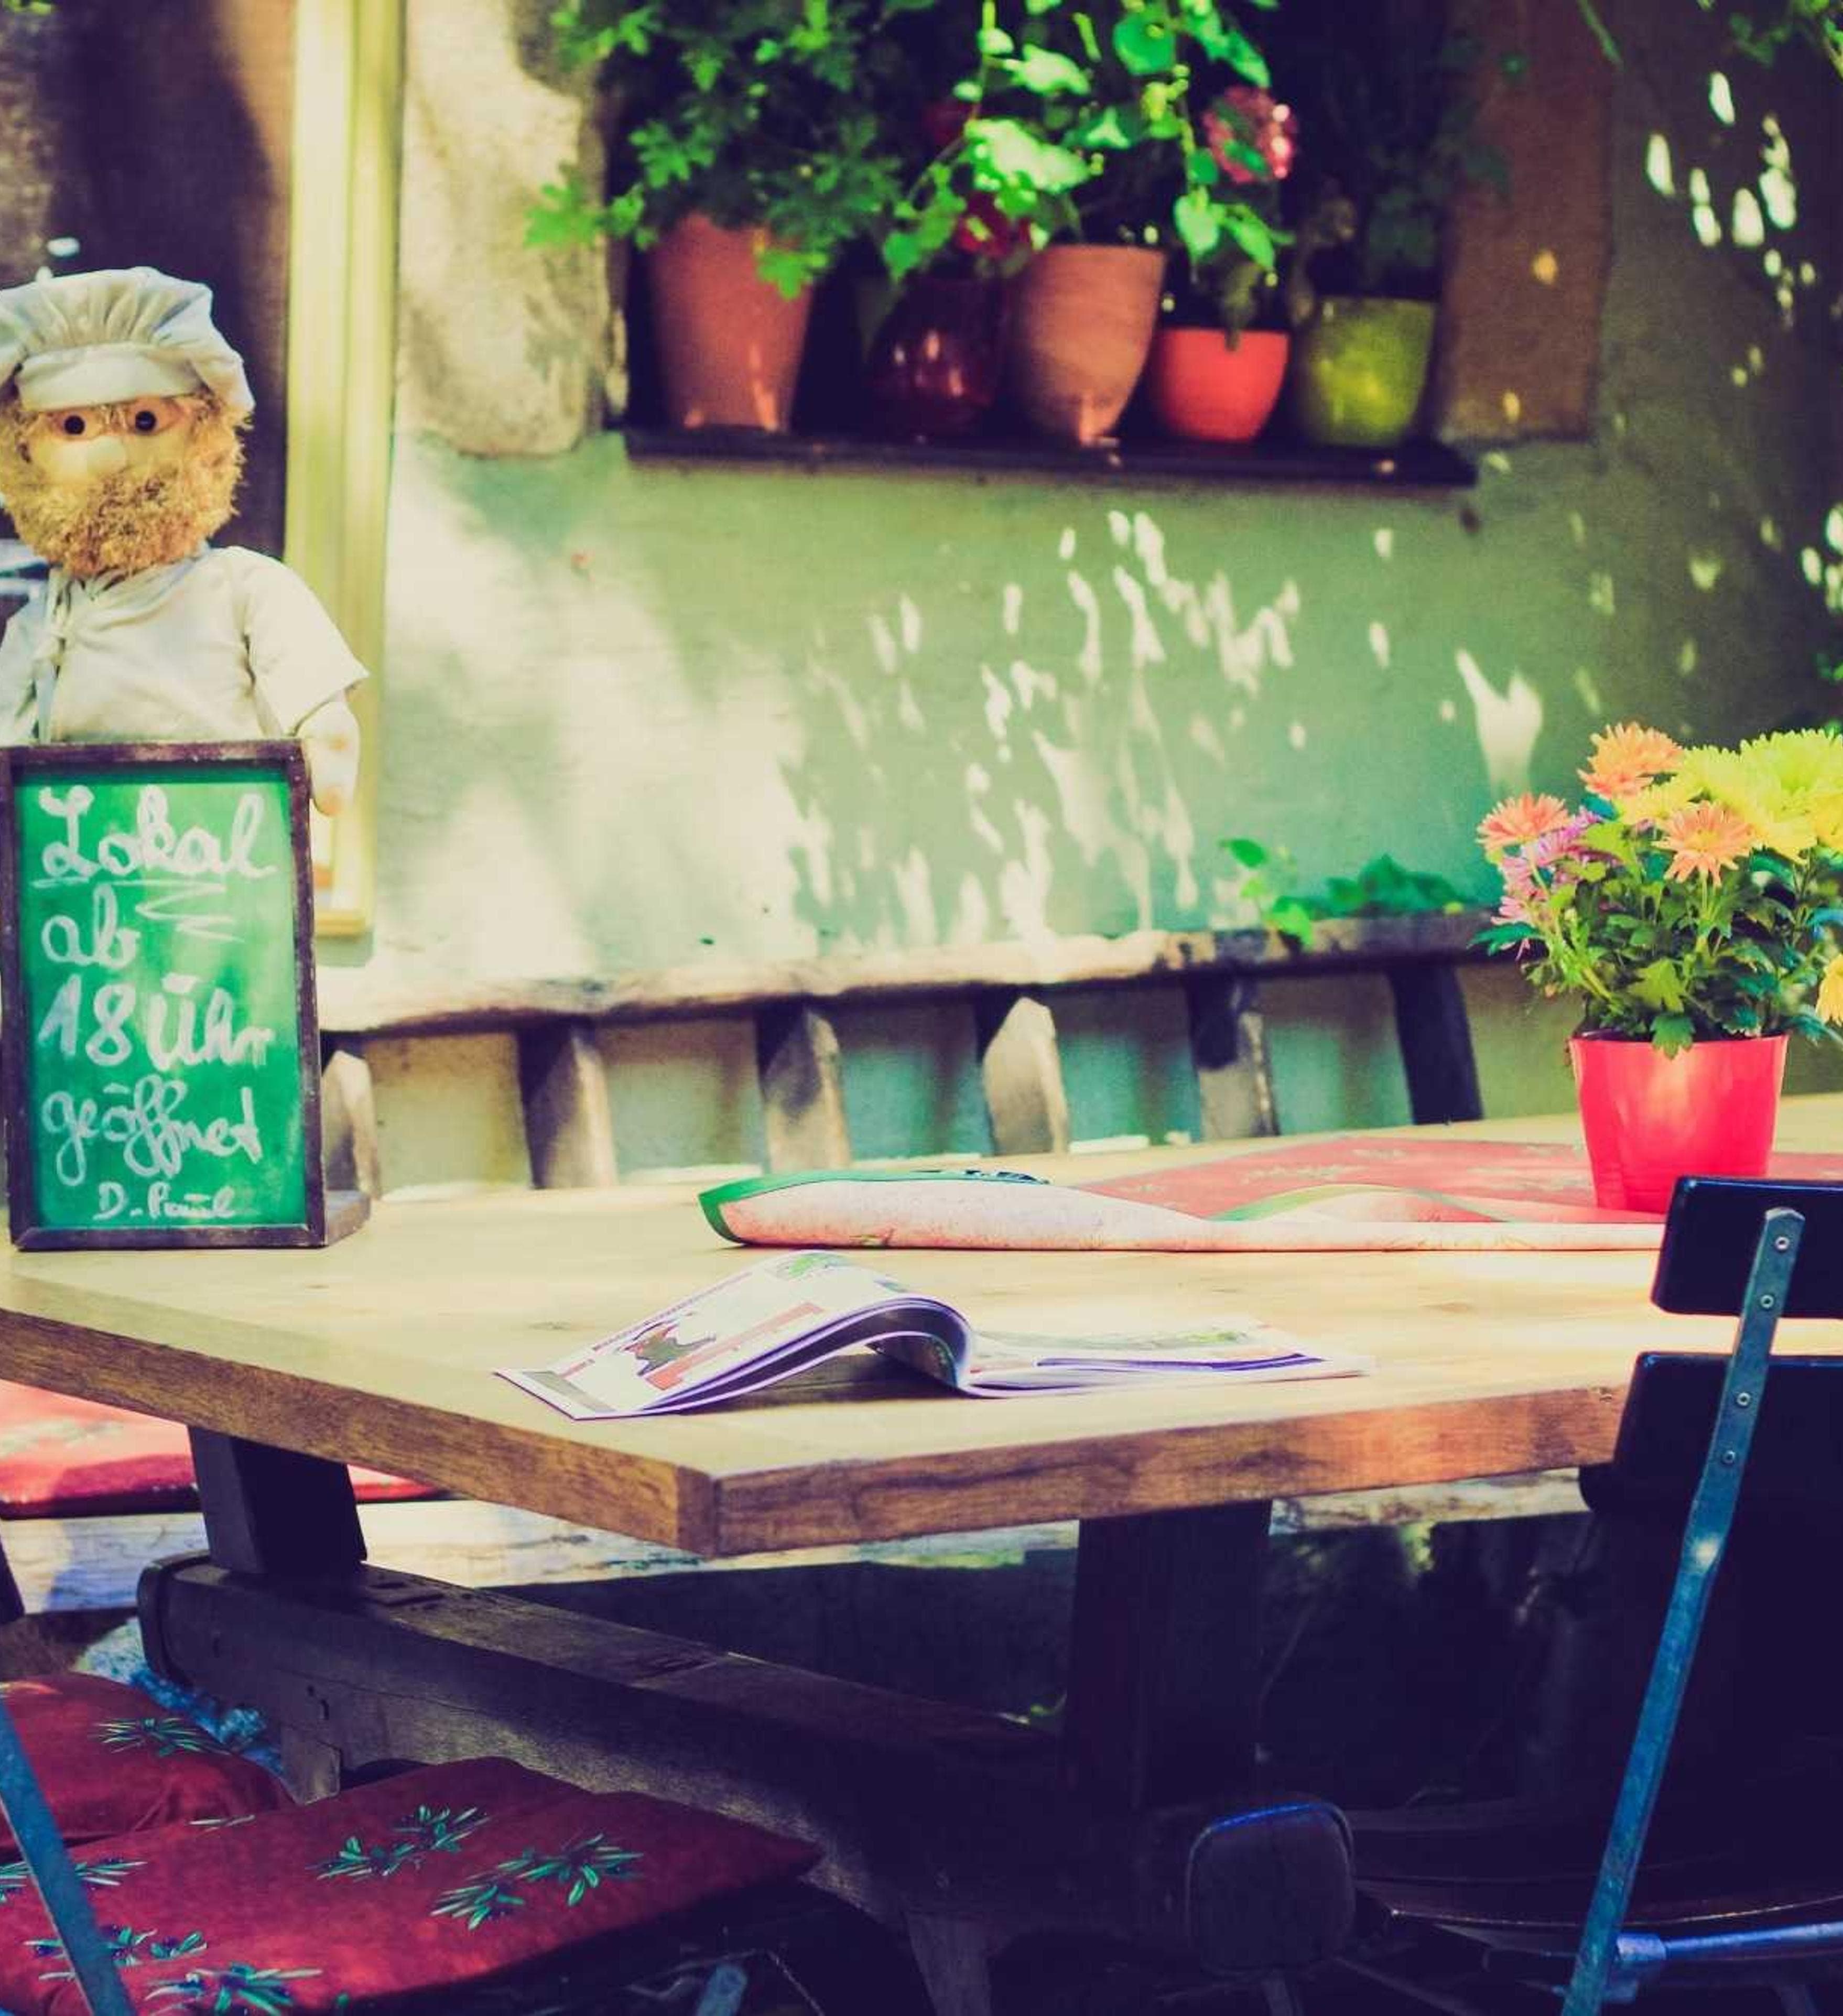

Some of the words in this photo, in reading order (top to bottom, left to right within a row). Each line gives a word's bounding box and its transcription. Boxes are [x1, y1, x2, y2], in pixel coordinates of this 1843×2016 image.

[38, 785, 277, 878] Lokal
[41, 884, 140, 970] ab
[38, 973, 135, 1066] 18
